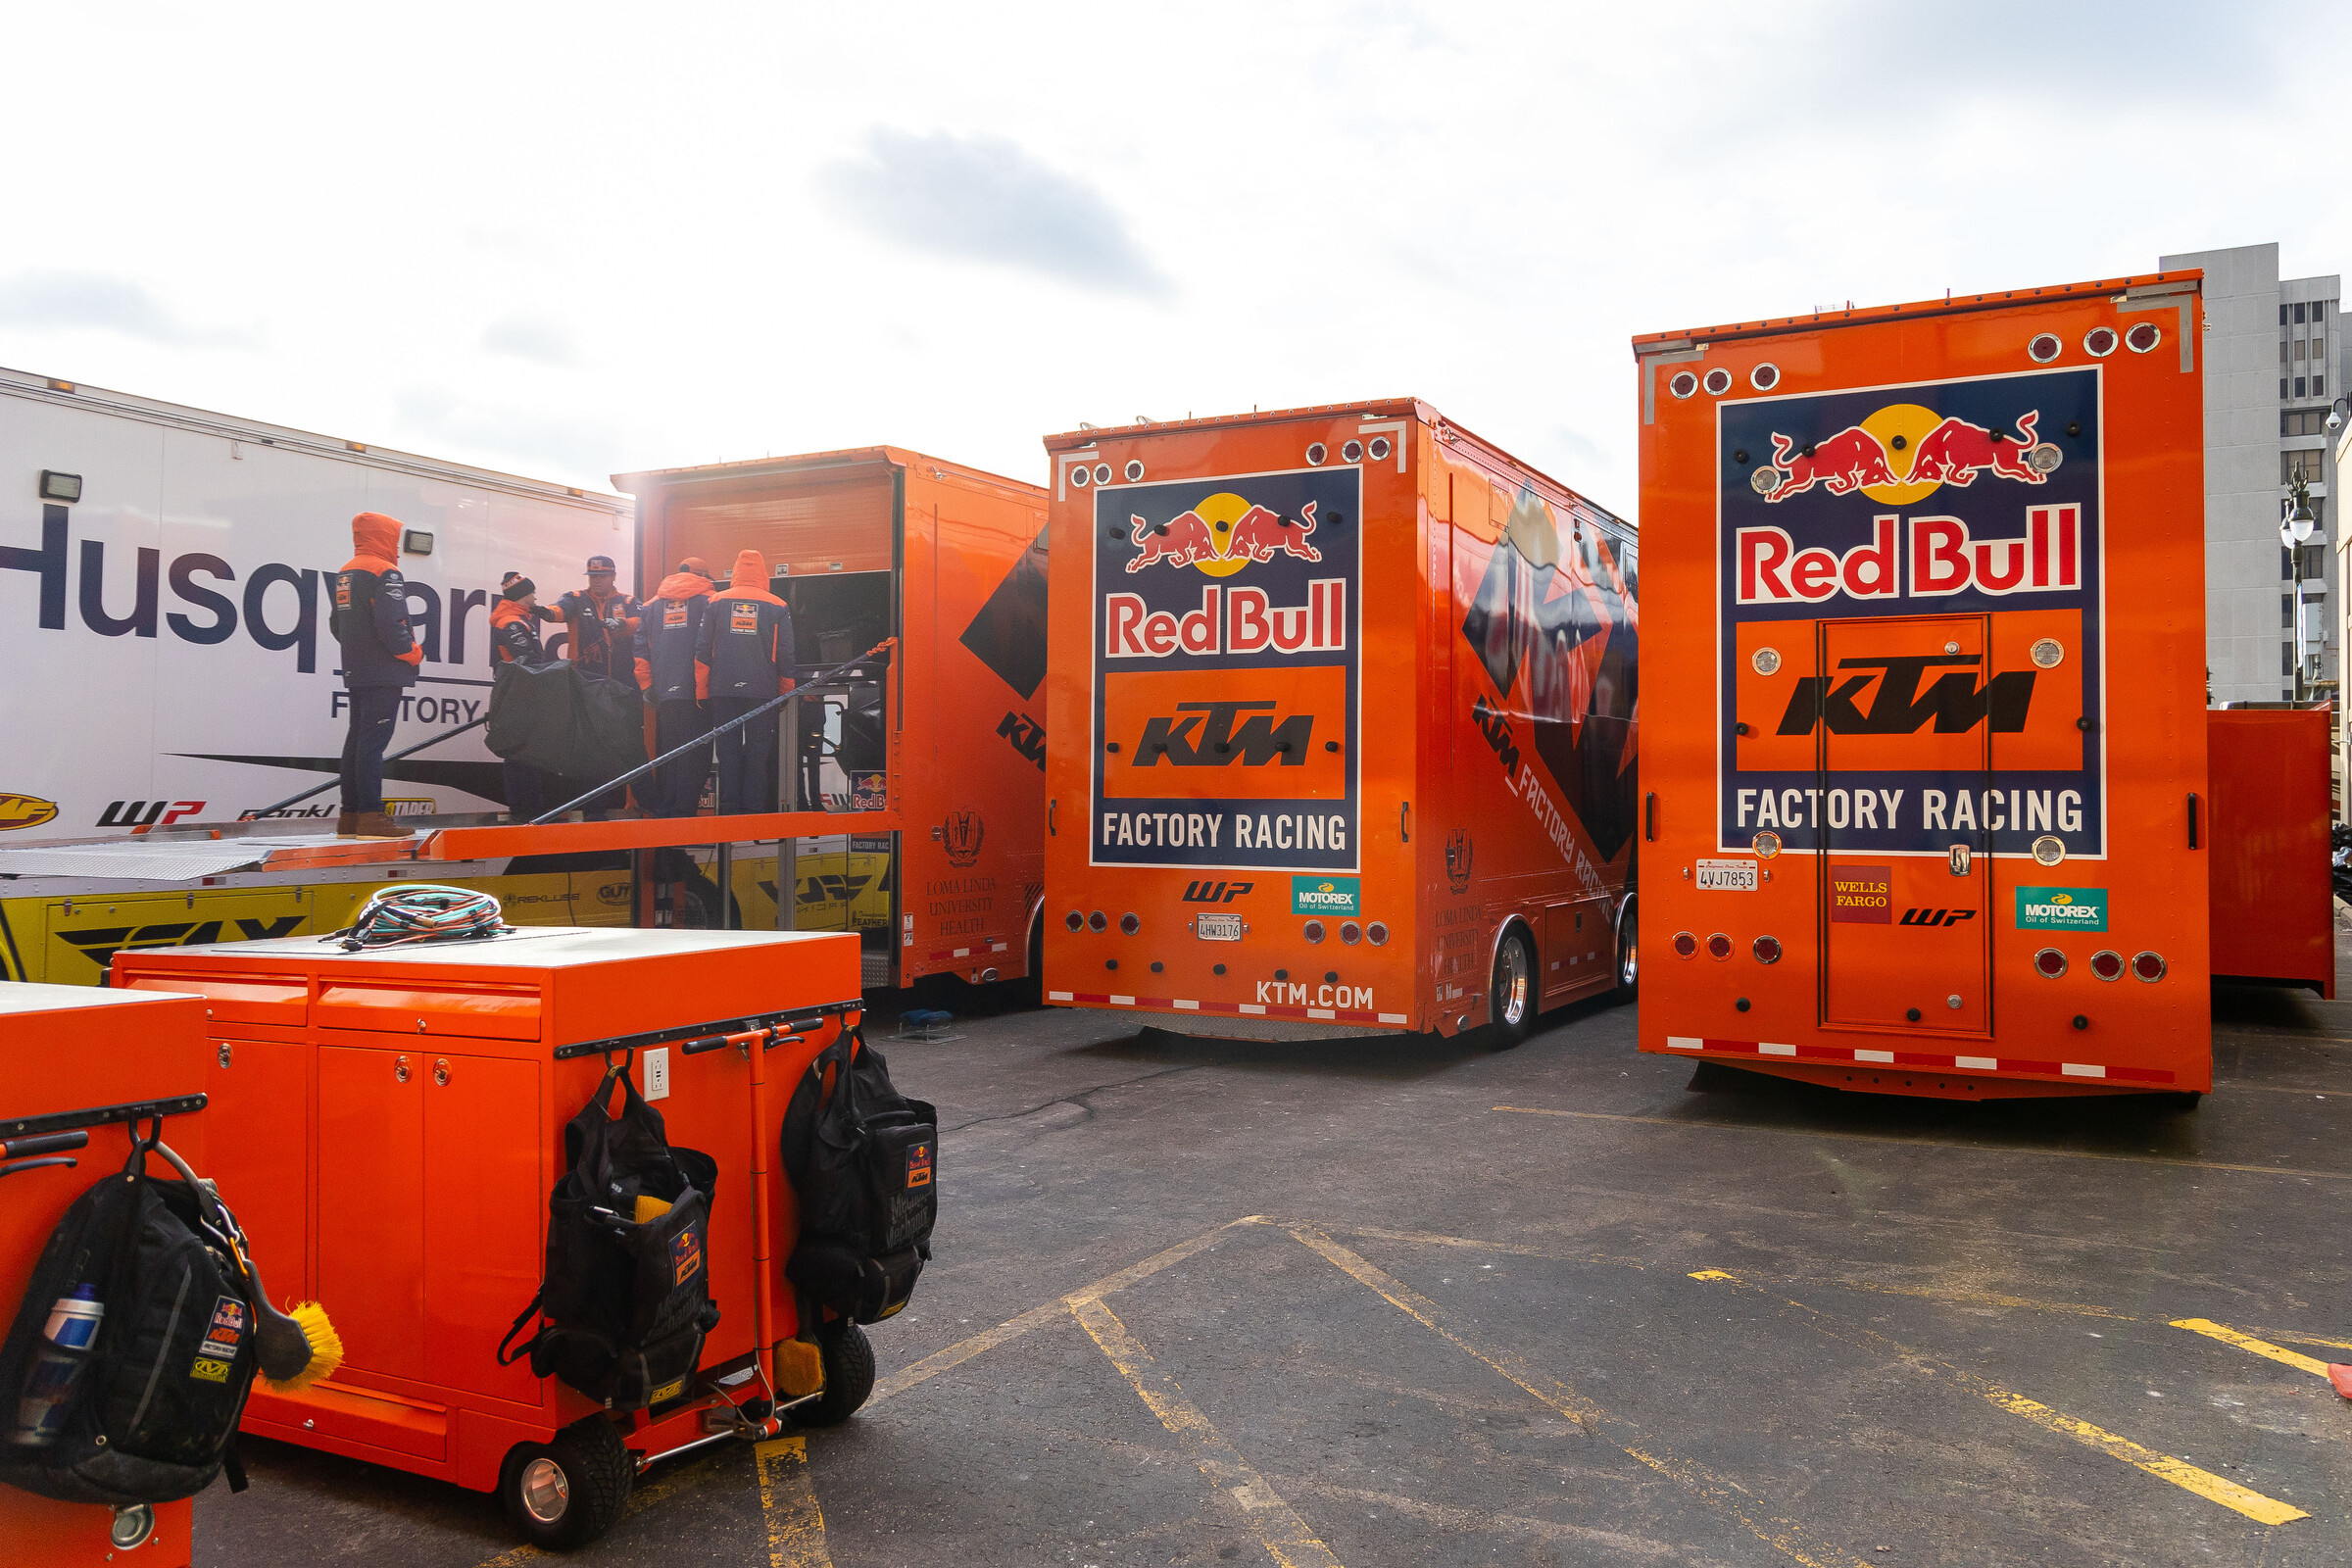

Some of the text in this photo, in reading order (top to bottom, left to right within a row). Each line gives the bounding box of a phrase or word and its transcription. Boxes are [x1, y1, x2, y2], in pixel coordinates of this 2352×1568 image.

[1737, 503, 2082, 605] Red Bull
[1105, 578, 1346, 658] Red Bull
[1776, 654, 2037, 736] KTM
[331, 691, 480, 724] FTORY
[1132, 701, 1314, 767] KTM
[1472, 693, 1521, 779] KTM
[95, 801, 207, 827] WP
[1737, 789, 2082, 832] FACTORY RACING
[1103, 812, 1346, 850] FACTORY RACING
[853, 841, 890, 850] FACTORY RAC
[926, 877, 997, 897] LOMA LINDA
[1700, 870, 1754, 887] 4VJ7853
[1835, 881, 1887, 894] WELLS
[599, 885, 632, 900] GUT
[1182, 880, 1254, 904] WP
[1299, 892, 1353, 905] MOTOREX
[1837, 895, 1887, 907] FARGO
[929, 897, 994, 916] UNIVERSITY
[2025, 905, 2098, 918] MOTOREX
[852, 916, 889, 927] FEATHER
[939, 917, 985, 936] HEALTH
[1435, 909, 1458, 928] LOMA
[1898, 908, 1978, 927] WP
[2050, 916, 2100, 925] Switzerland
[1200, 923, 1240, 937] 4HW3176
[1436, 929, 1480, 953] UNIVERSITY
[1444, 954, 1475, 975] HEALTH
[1256, 980, 1373, 1010] KTM.COM
[910, 1171, 928, 1184] KTM
[209, 1327, 240, 1345] KTM
